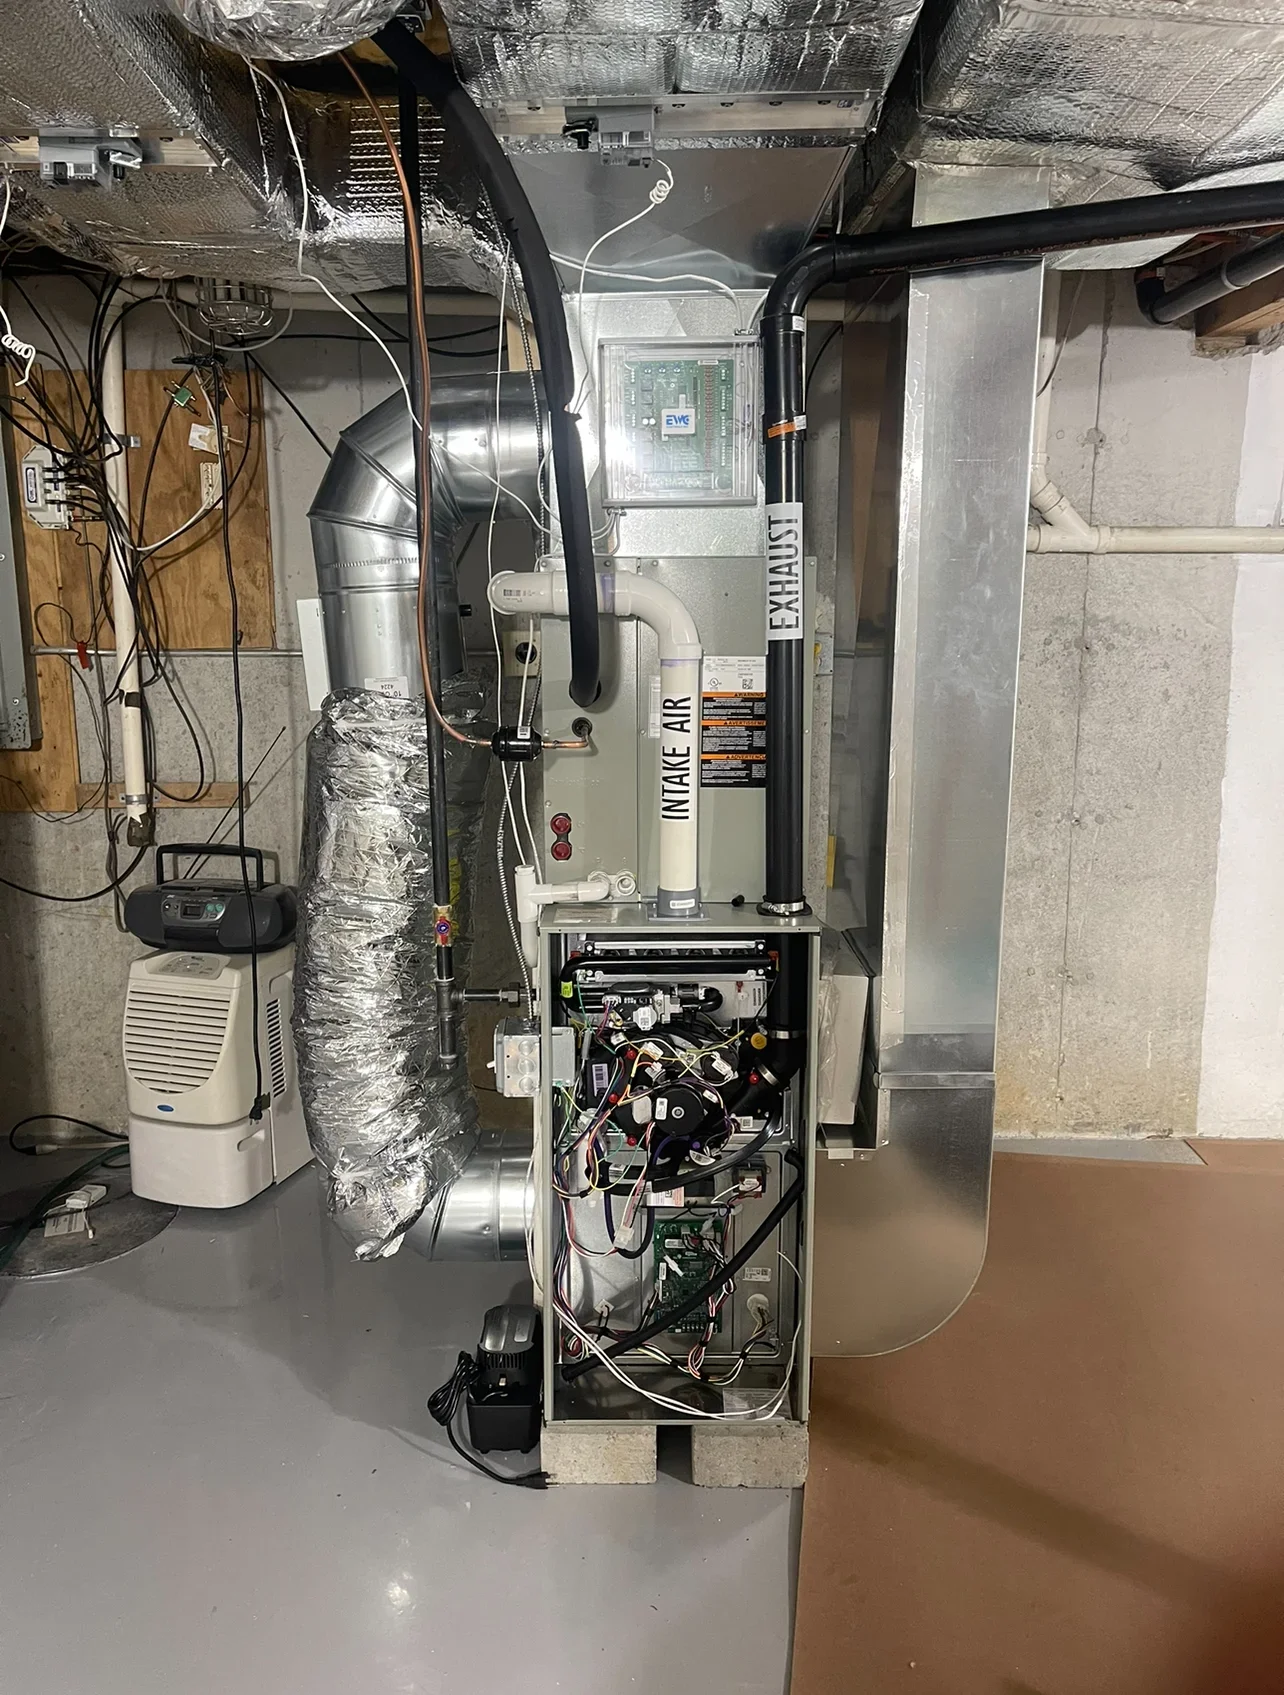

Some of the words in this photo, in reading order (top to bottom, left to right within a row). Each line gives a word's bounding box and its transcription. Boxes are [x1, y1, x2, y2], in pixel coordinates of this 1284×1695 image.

[665, 414, 690, 426] EWC
[767, 514, 800, 630] EXHAUST
[662, 696, 692, 734] AIR
[661, 746, 690, 820] INTAKE
